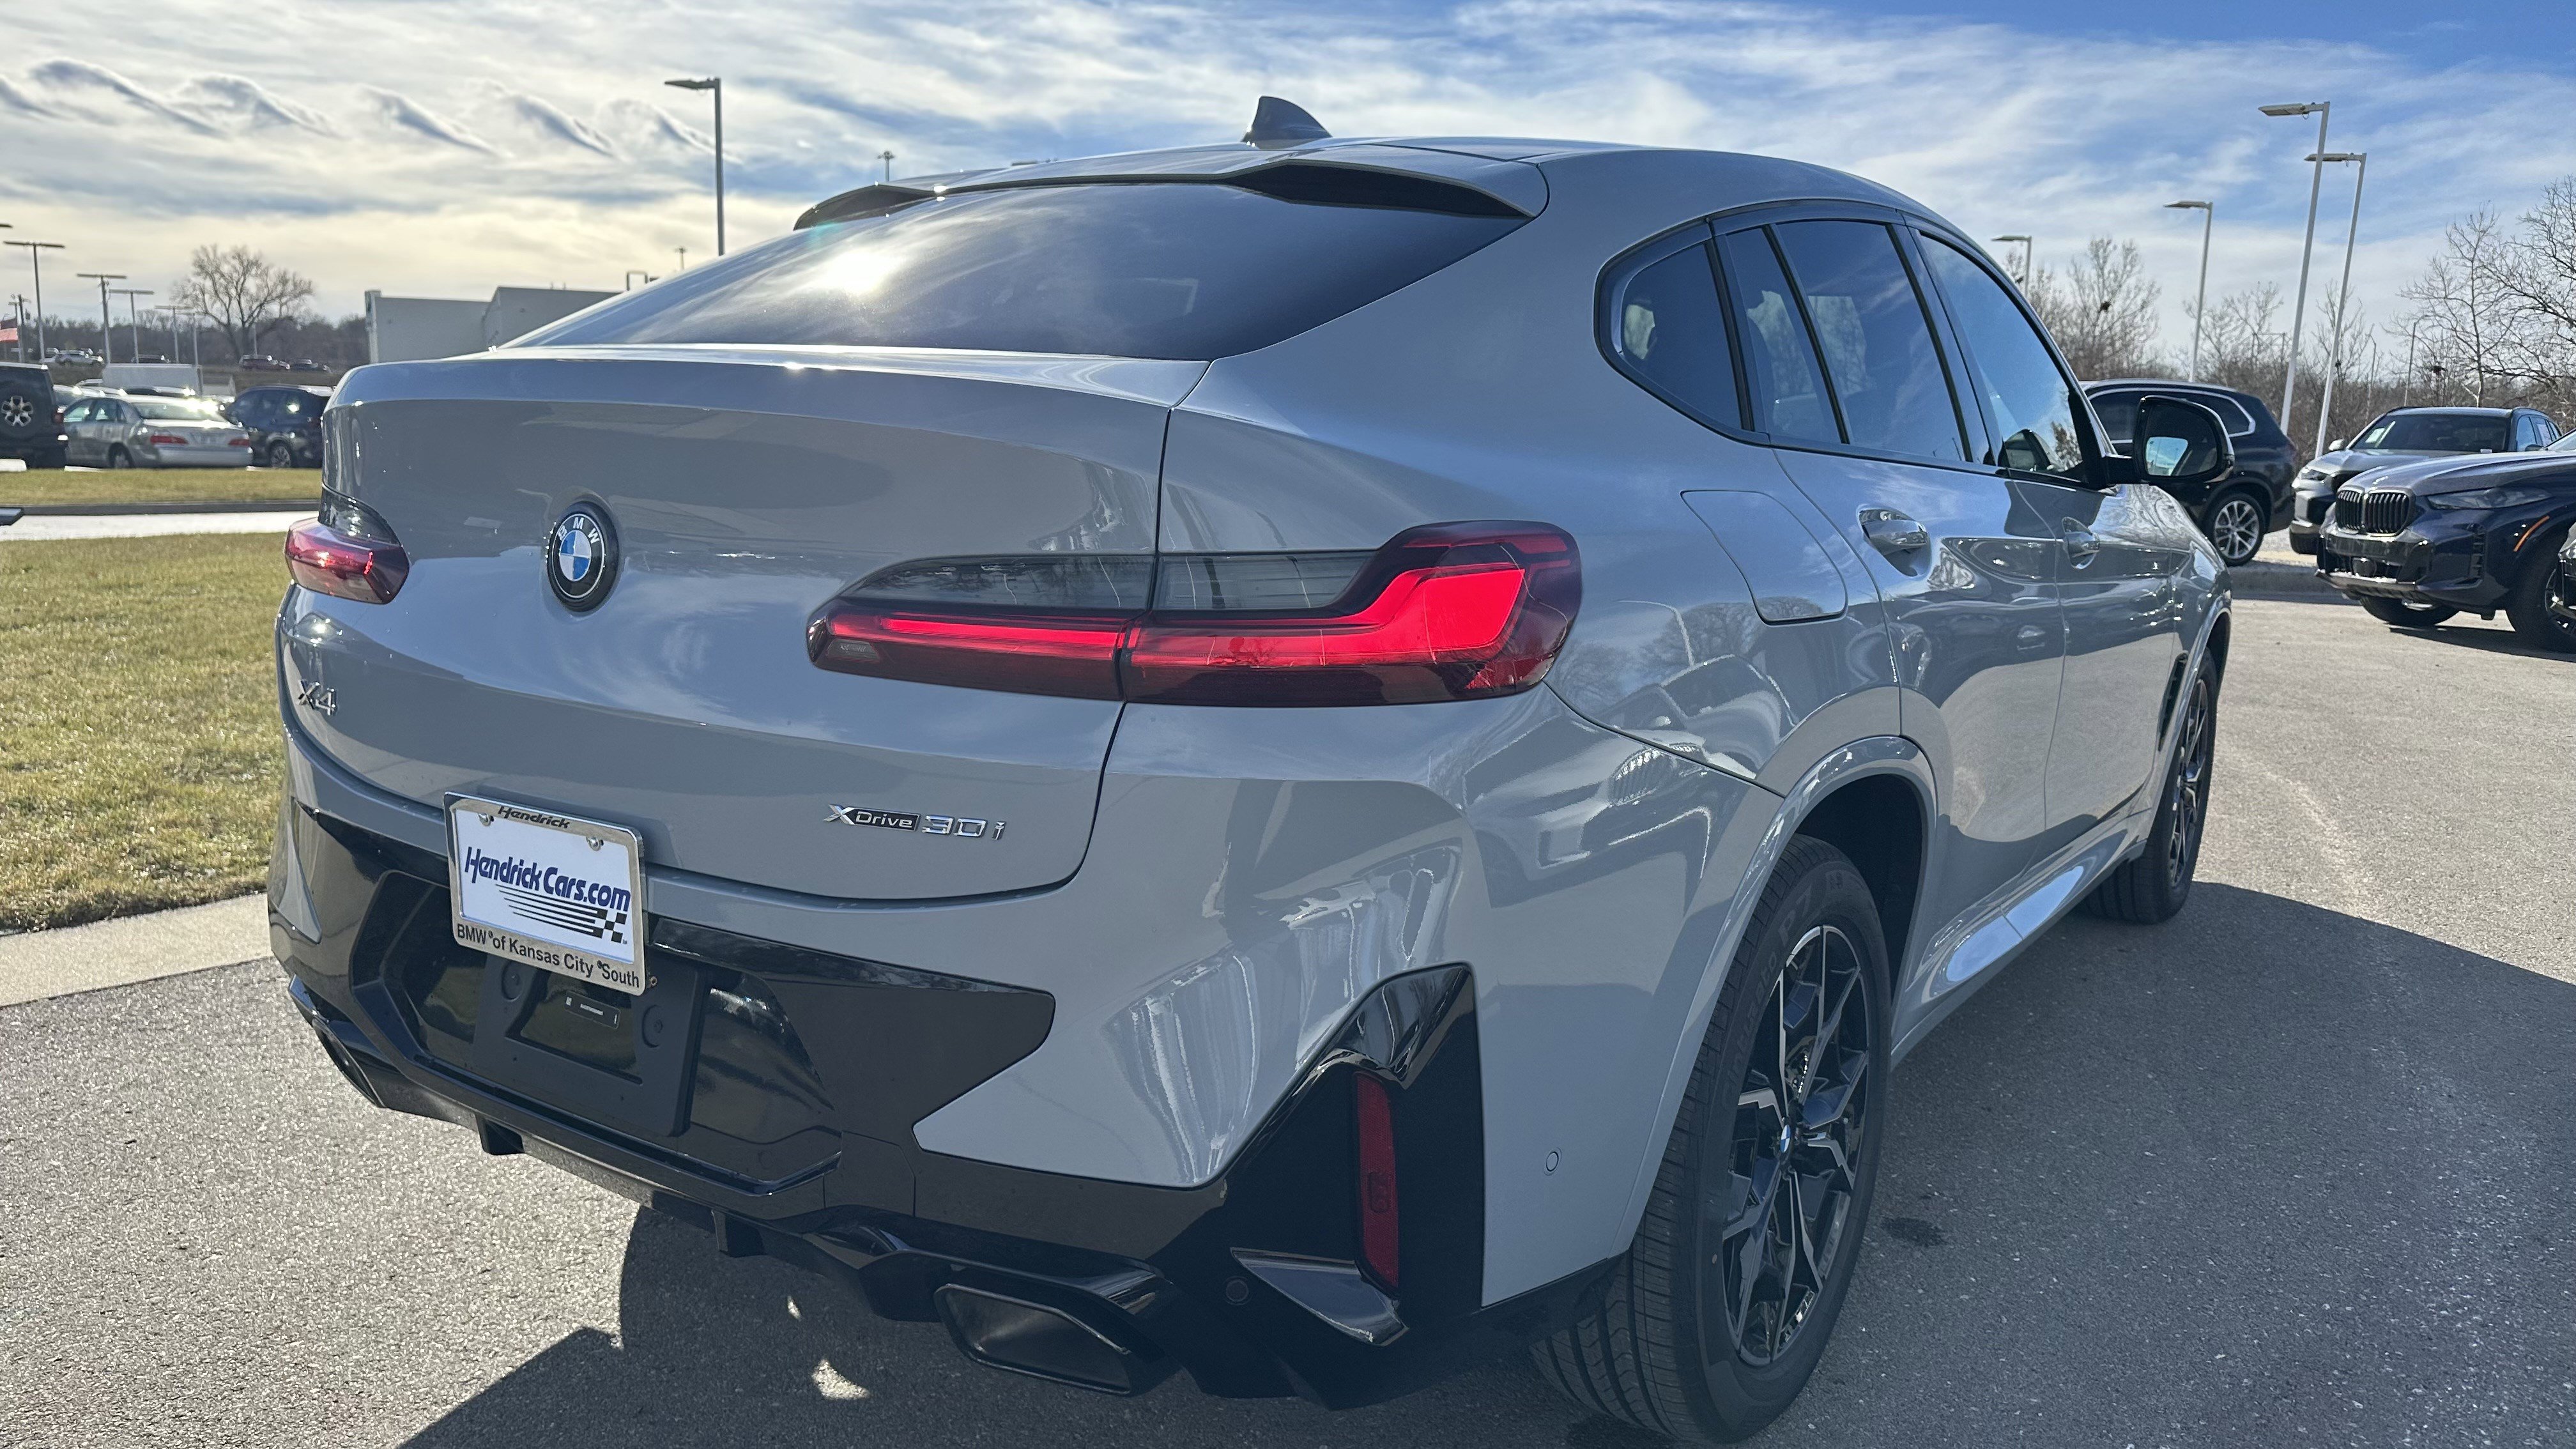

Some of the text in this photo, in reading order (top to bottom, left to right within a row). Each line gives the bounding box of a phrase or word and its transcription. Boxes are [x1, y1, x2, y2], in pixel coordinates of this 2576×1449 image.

[558, 516, 601, 544] BMW
[297, 679, 337, 716] X4
[498, 806, 570, 829] Hendrick
[1778, 885, 1813, 947] P7
[493, 935, 506, 950] of
[509, 937, 560, 966] Kansas
[564, 953, 594, 978] City
[602, 963, 640, 988] South
